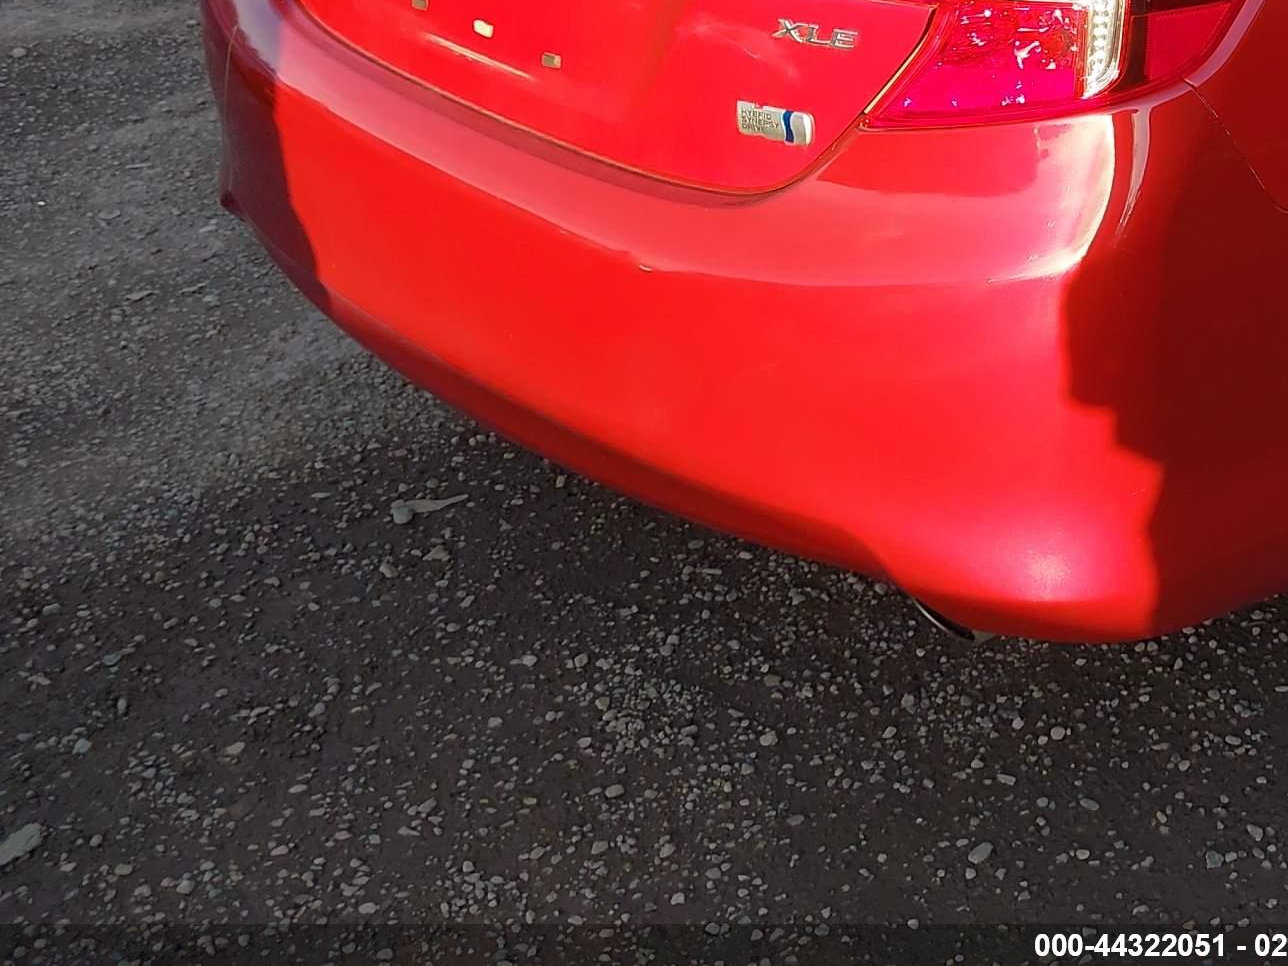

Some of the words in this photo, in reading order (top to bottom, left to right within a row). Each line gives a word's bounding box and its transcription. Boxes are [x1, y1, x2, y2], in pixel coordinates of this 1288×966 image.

[771, 17, 859, 50] XLE
[741, 107, 772, 121] HYBRID
[741, 115, 779, 129] SYNERGY
